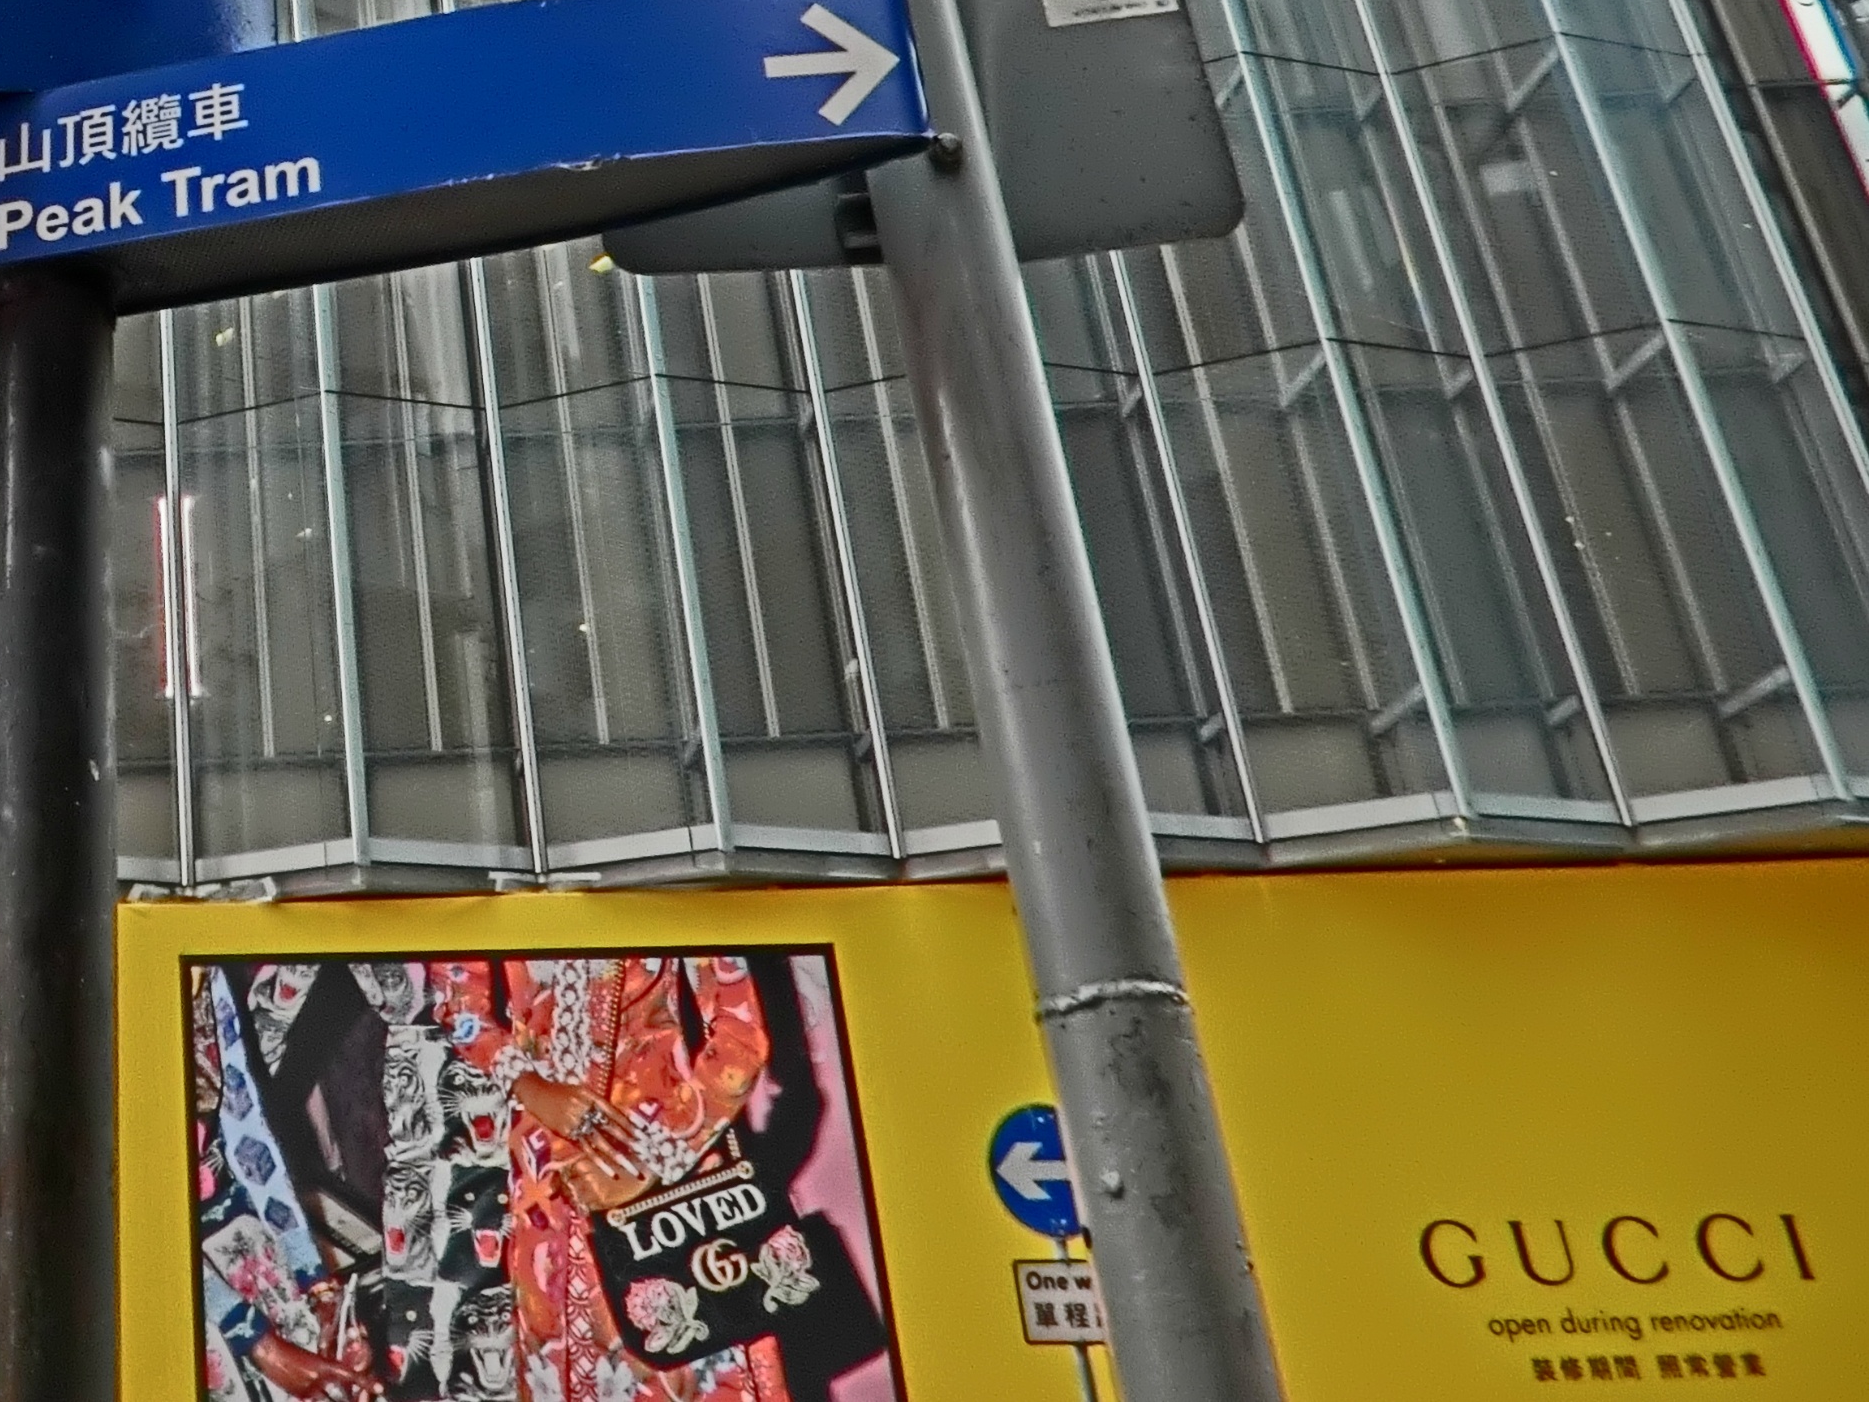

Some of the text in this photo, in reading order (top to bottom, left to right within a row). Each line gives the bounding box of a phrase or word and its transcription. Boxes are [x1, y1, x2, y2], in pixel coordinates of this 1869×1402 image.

[161, 156, 322, 217] Tram
[619, 1183, 767, 1261] LOVED
[1419, 1212, 1816, 1289] GUCCI
[1026, 1271, 1068, 1291] One
[1034, 1301, 1102, 1328] 單程
[1487, 1307, 1783, 1342] open during renovation
